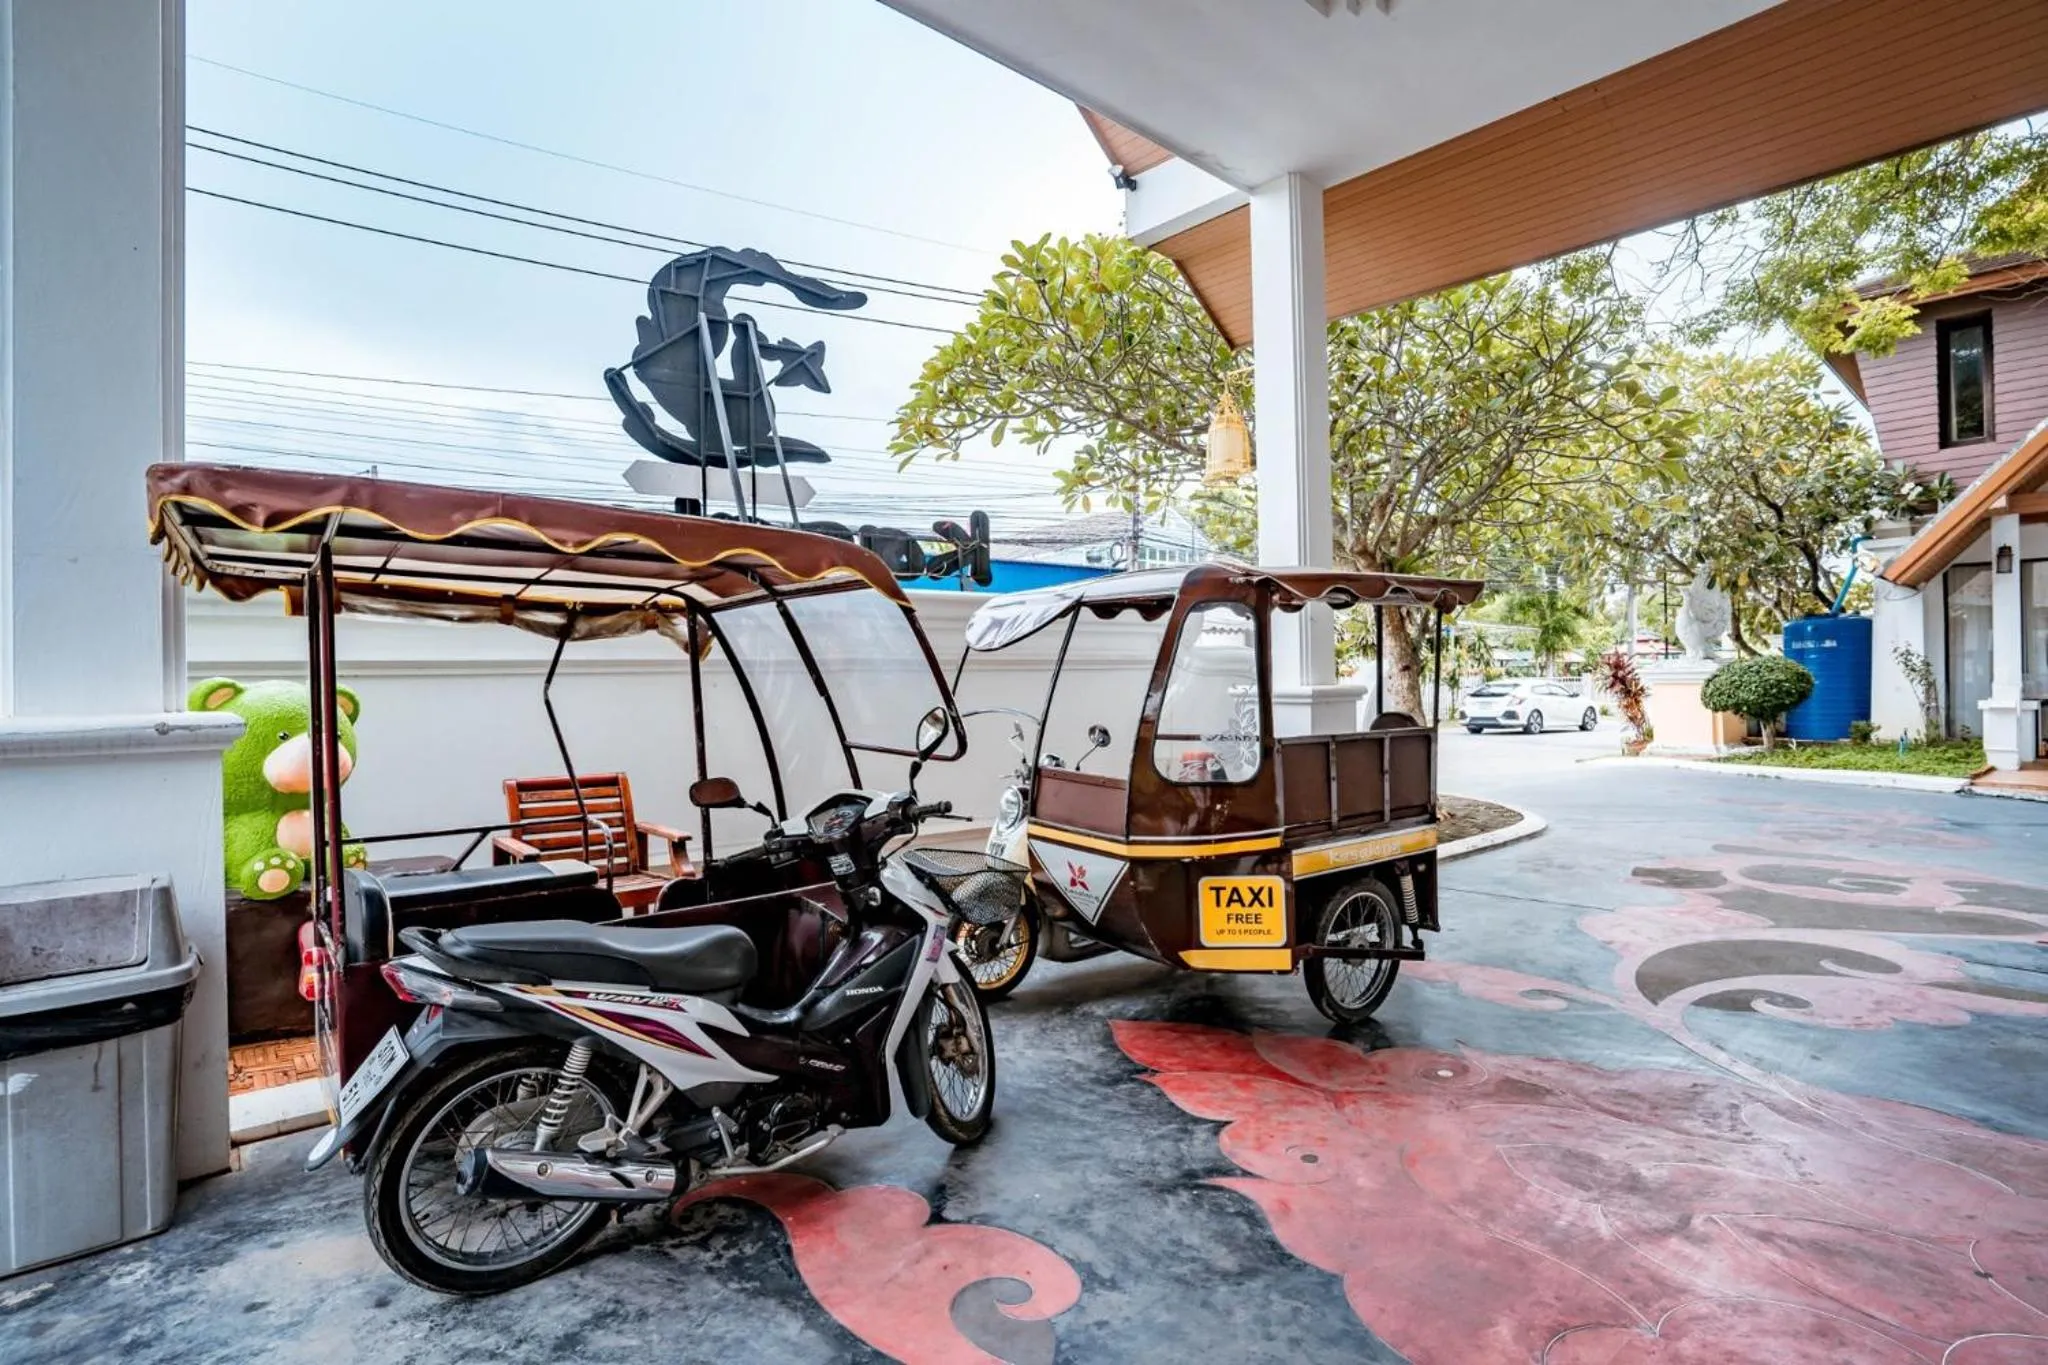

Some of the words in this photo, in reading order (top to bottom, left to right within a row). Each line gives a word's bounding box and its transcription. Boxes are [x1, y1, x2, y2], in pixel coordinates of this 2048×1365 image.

[1208, 886, 1274, 908] TAXI
[1226, 913, 1263, 925] FREE
[845, 986, 884, 997] HONDA
